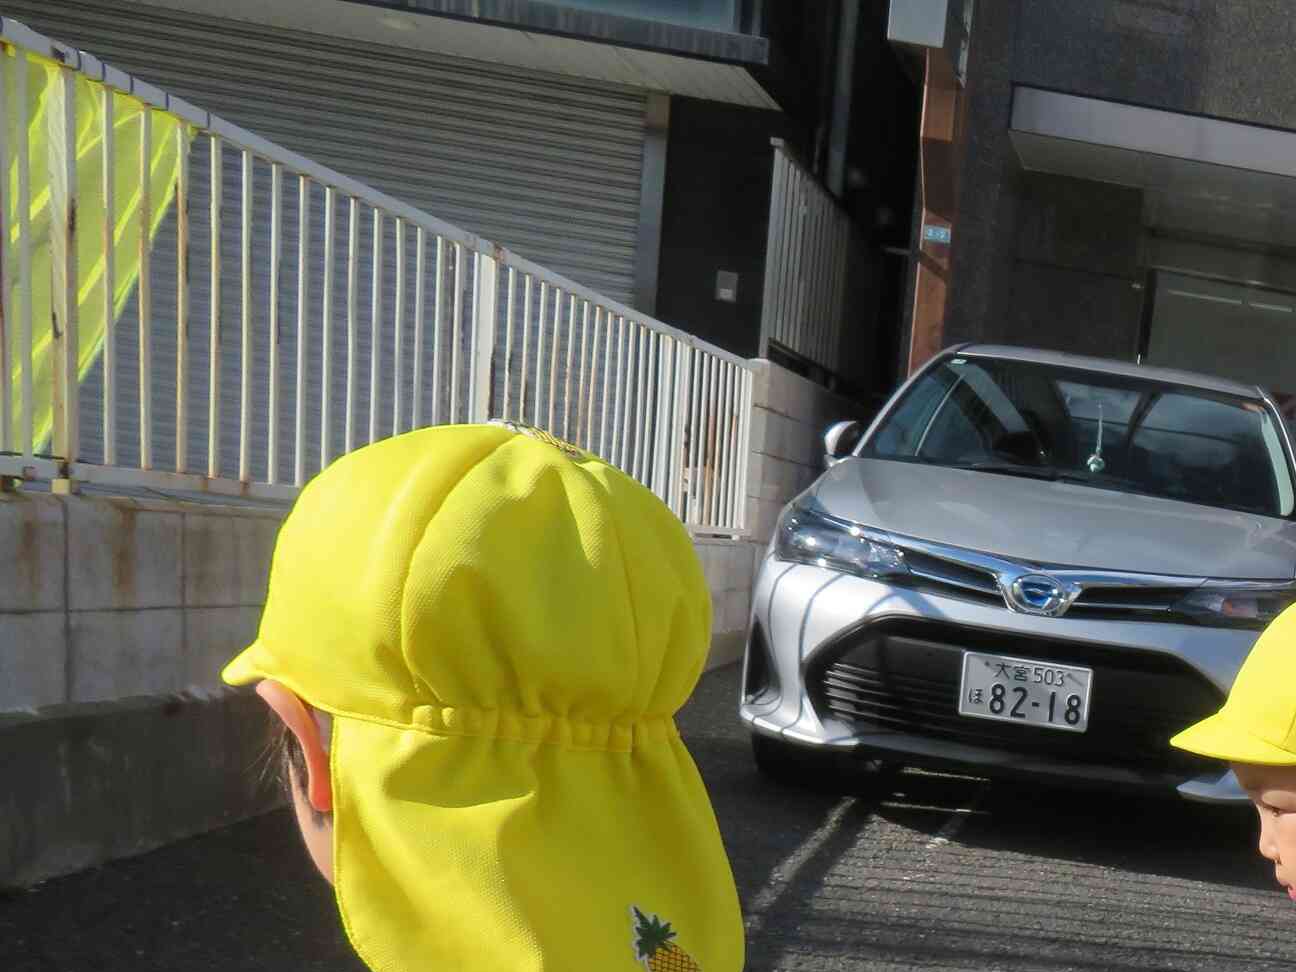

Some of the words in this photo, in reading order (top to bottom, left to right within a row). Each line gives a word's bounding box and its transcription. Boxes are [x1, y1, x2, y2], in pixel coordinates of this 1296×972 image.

[994, 662, 1031, 682] 大宮
[1033, 667, 1065, 687] 503
[968, 688, 984, 705] ほ
[989, 683, 1082, 725] 82-18
